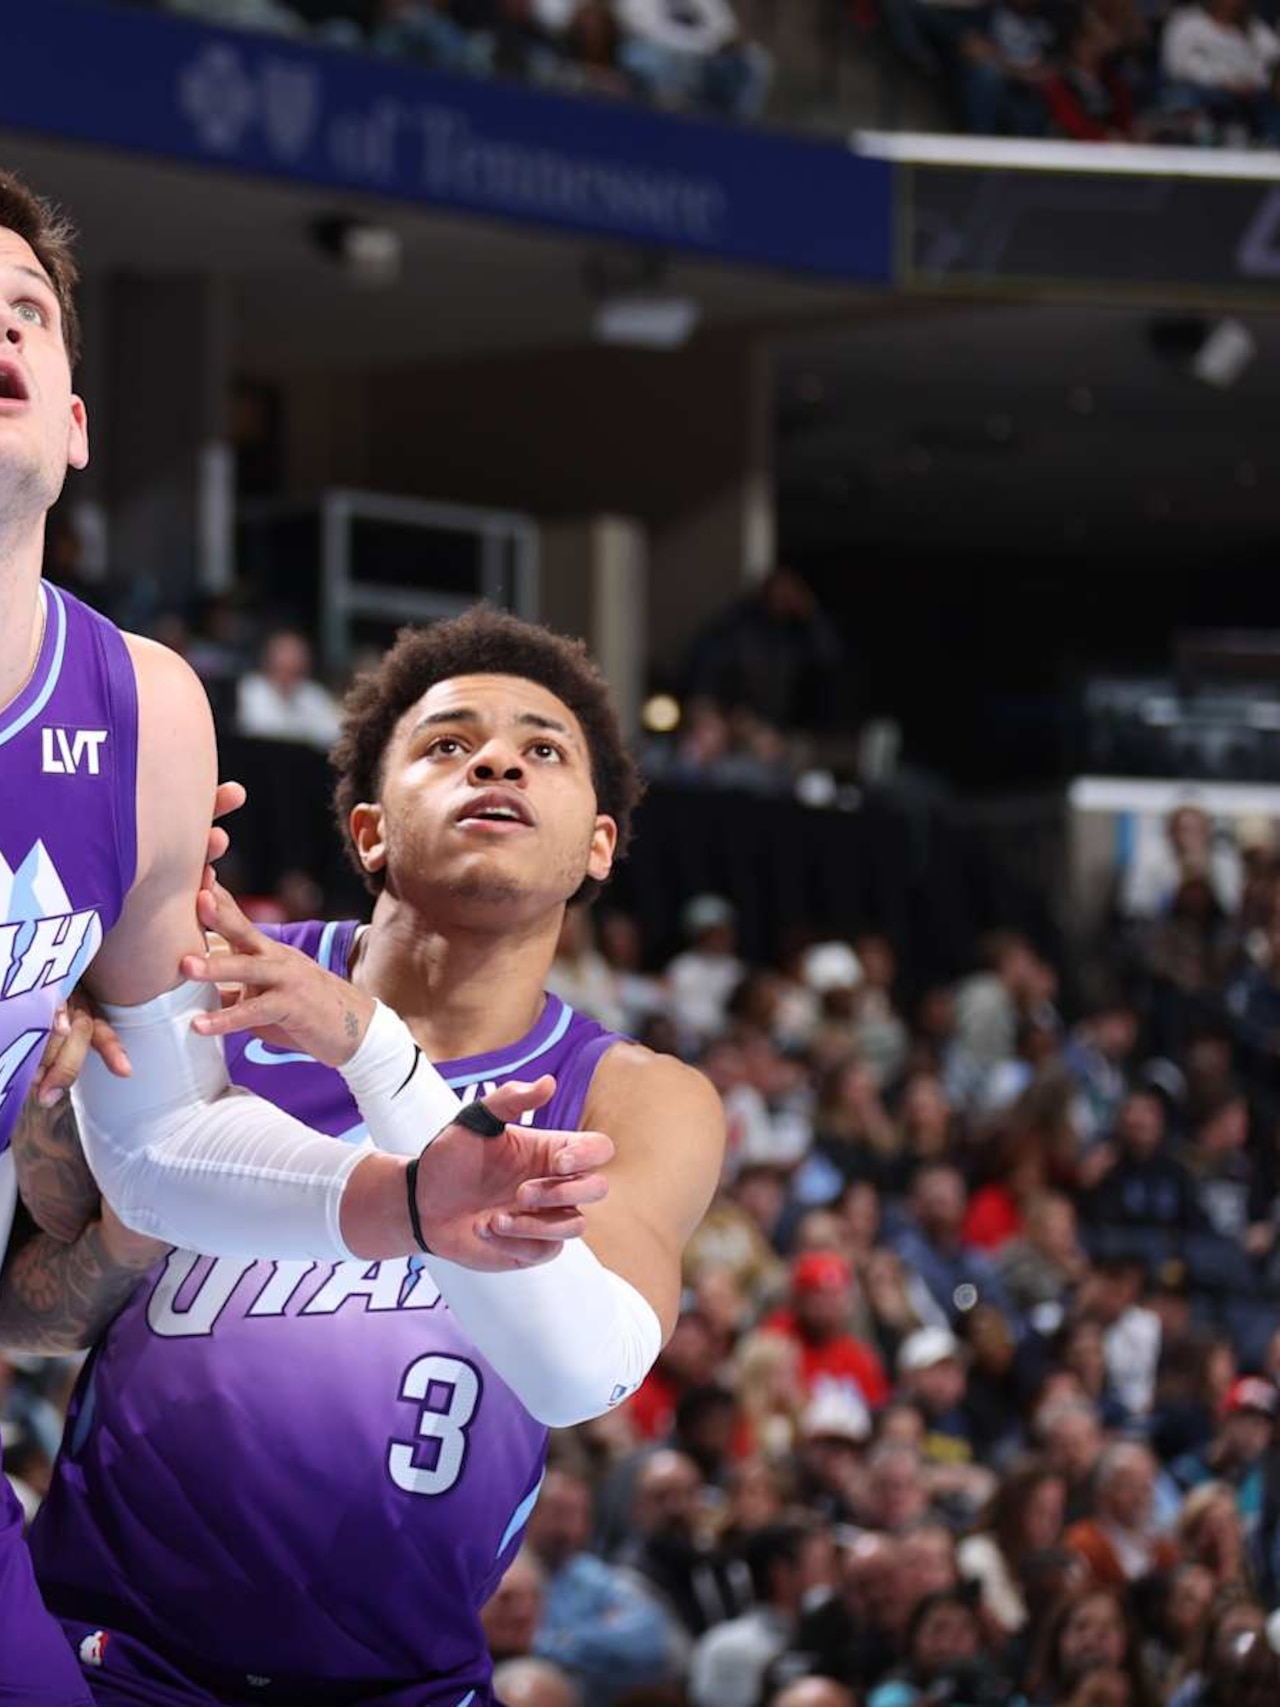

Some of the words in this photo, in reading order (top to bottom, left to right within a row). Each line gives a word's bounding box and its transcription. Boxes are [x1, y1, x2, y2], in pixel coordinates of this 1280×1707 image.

[418, 102, 727, 246] Tennessee
[42, 727, 108, 775] LVT
[387, 1352, 484, 1496] 3
